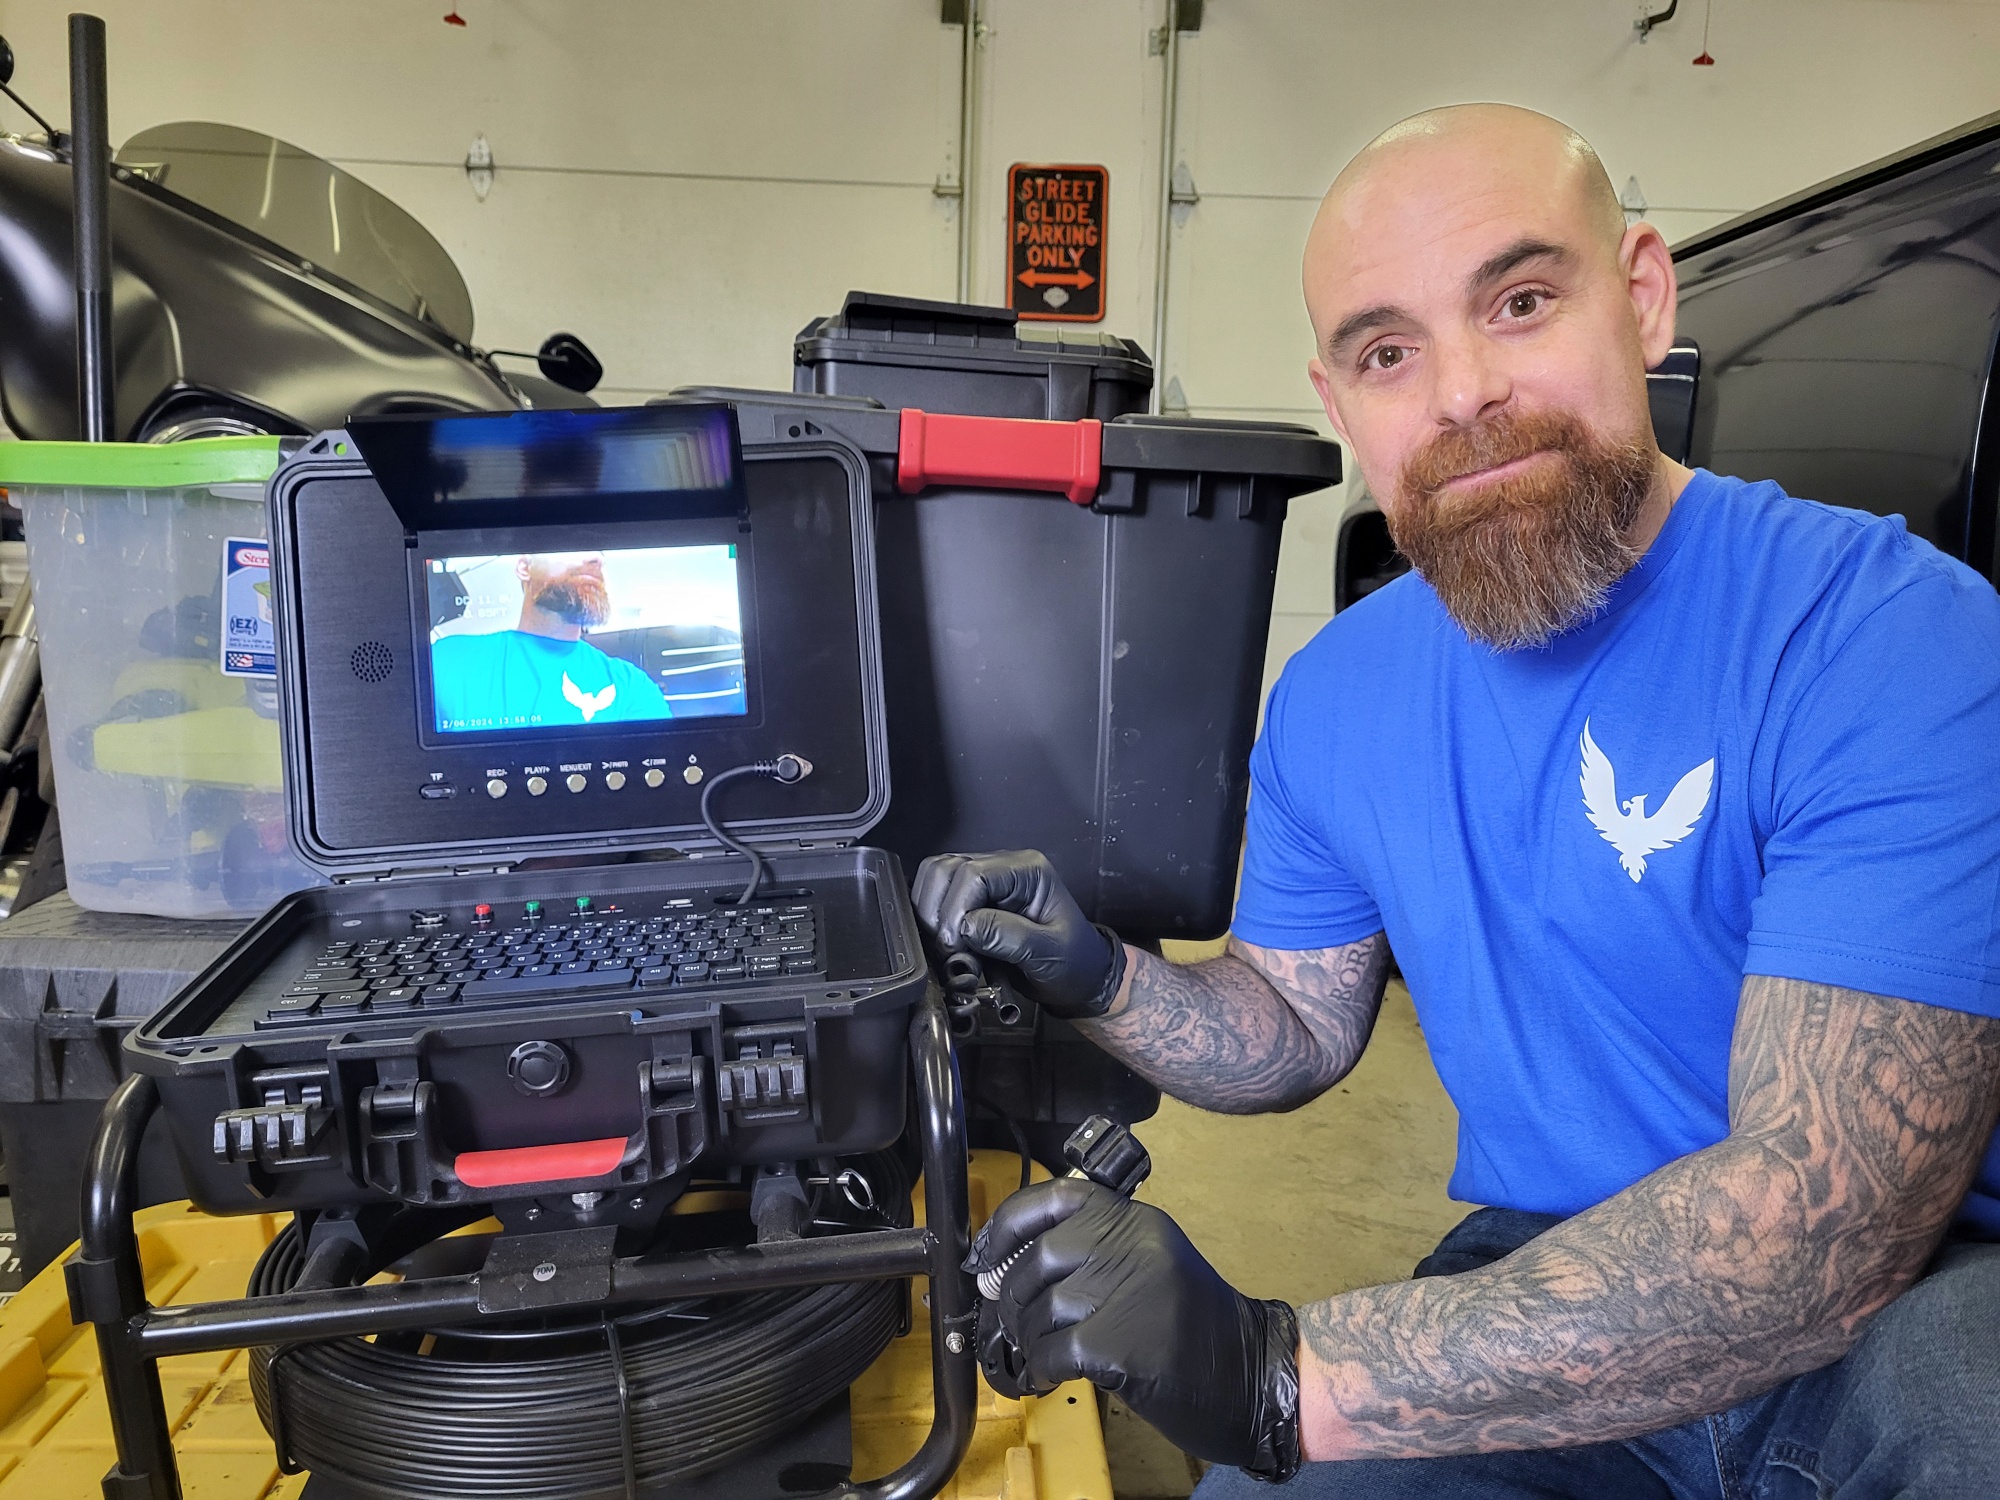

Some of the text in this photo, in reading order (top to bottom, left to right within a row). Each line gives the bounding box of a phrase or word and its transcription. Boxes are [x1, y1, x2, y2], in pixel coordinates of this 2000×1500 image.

[1021, 177, 1096, 201] STREET
[1025, 201, 1091, 224] GLIDE
[1016, 222, 1098, 247] PARKING
[1027, 245, 1086, 268] ONLY
[235, 618, 252, 629] EZ
[430, 772, 444, 781] TF
[535, 1265, 554, 1276] 70M
